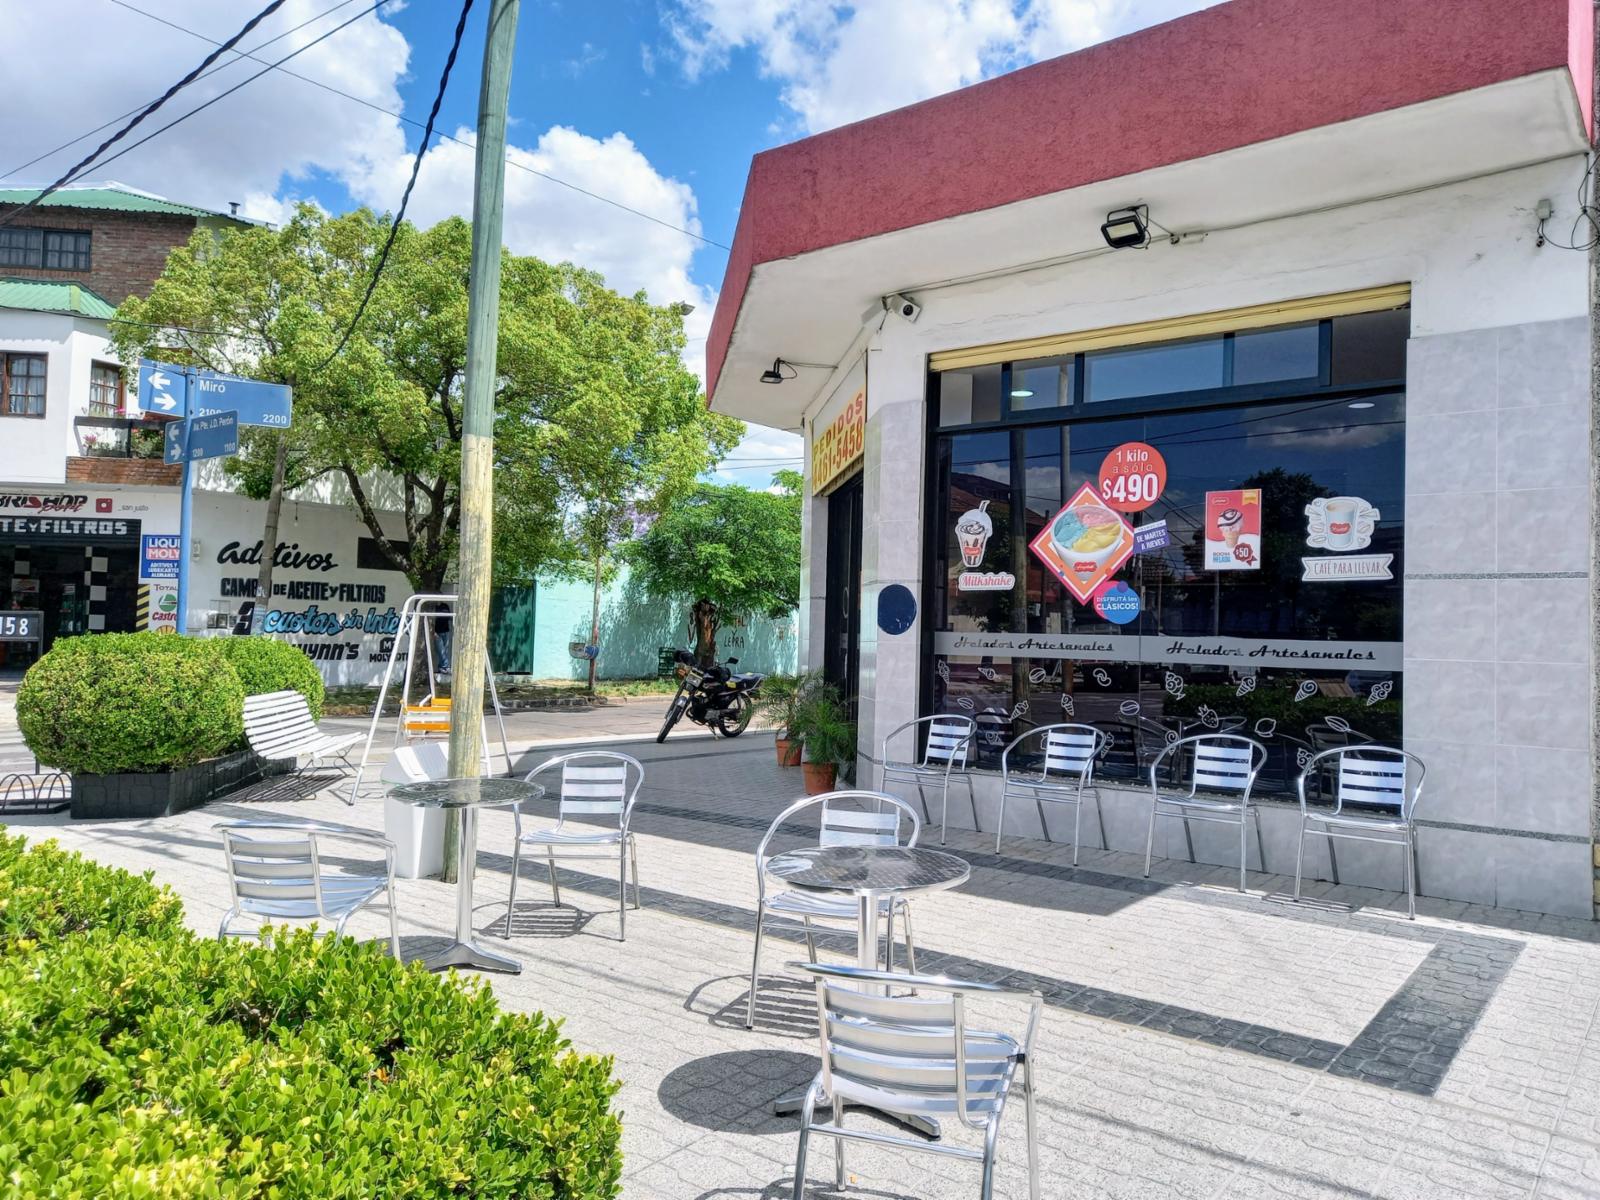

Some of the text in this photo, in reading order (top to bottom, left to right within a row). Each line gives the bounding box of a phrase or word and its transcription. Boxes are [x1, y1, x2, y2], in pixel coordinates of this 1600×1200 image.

[199, 379, 226, 393] Miró
[219, 416, 234, 426] Perón
[262, 413, 288, 424] 2200
[813, 393, 863, 461] PEDIDOS
[1115, 449, 1149, 463] 1 kilo
[1112, 462, 1153, 473] a sólo
[1102, 473, 1159, 503] $490
[40, 519, 128, 535] FILTROS
[1136, 529, 1166, 543] DE MARTES
[148, 548, 180, 559] MOLY
[217, 540, 338, 572] Adtivos
[1235, 547, 1249, 557] $50
[1314, 561, 1381, 575] CAFÉ PARA LLEVAR
[963, 574, 1012, 587] Milkshake
[220, 578, 272, 598] CAMB
[273, 584, 287, 595] DE
[287, 581, 329, 600] ACEITE
[339, 583, 386, 604] FILTROS
[1096, 601, 1139, 611] CLÁSICOS!
[152, 612, 177, 621] Castro
[363, 607, 410, 635] Inte
[954, 636, 1114, 652] Helados Artesanales
[1166, 641, 1376, 661] Helados Artesanales
